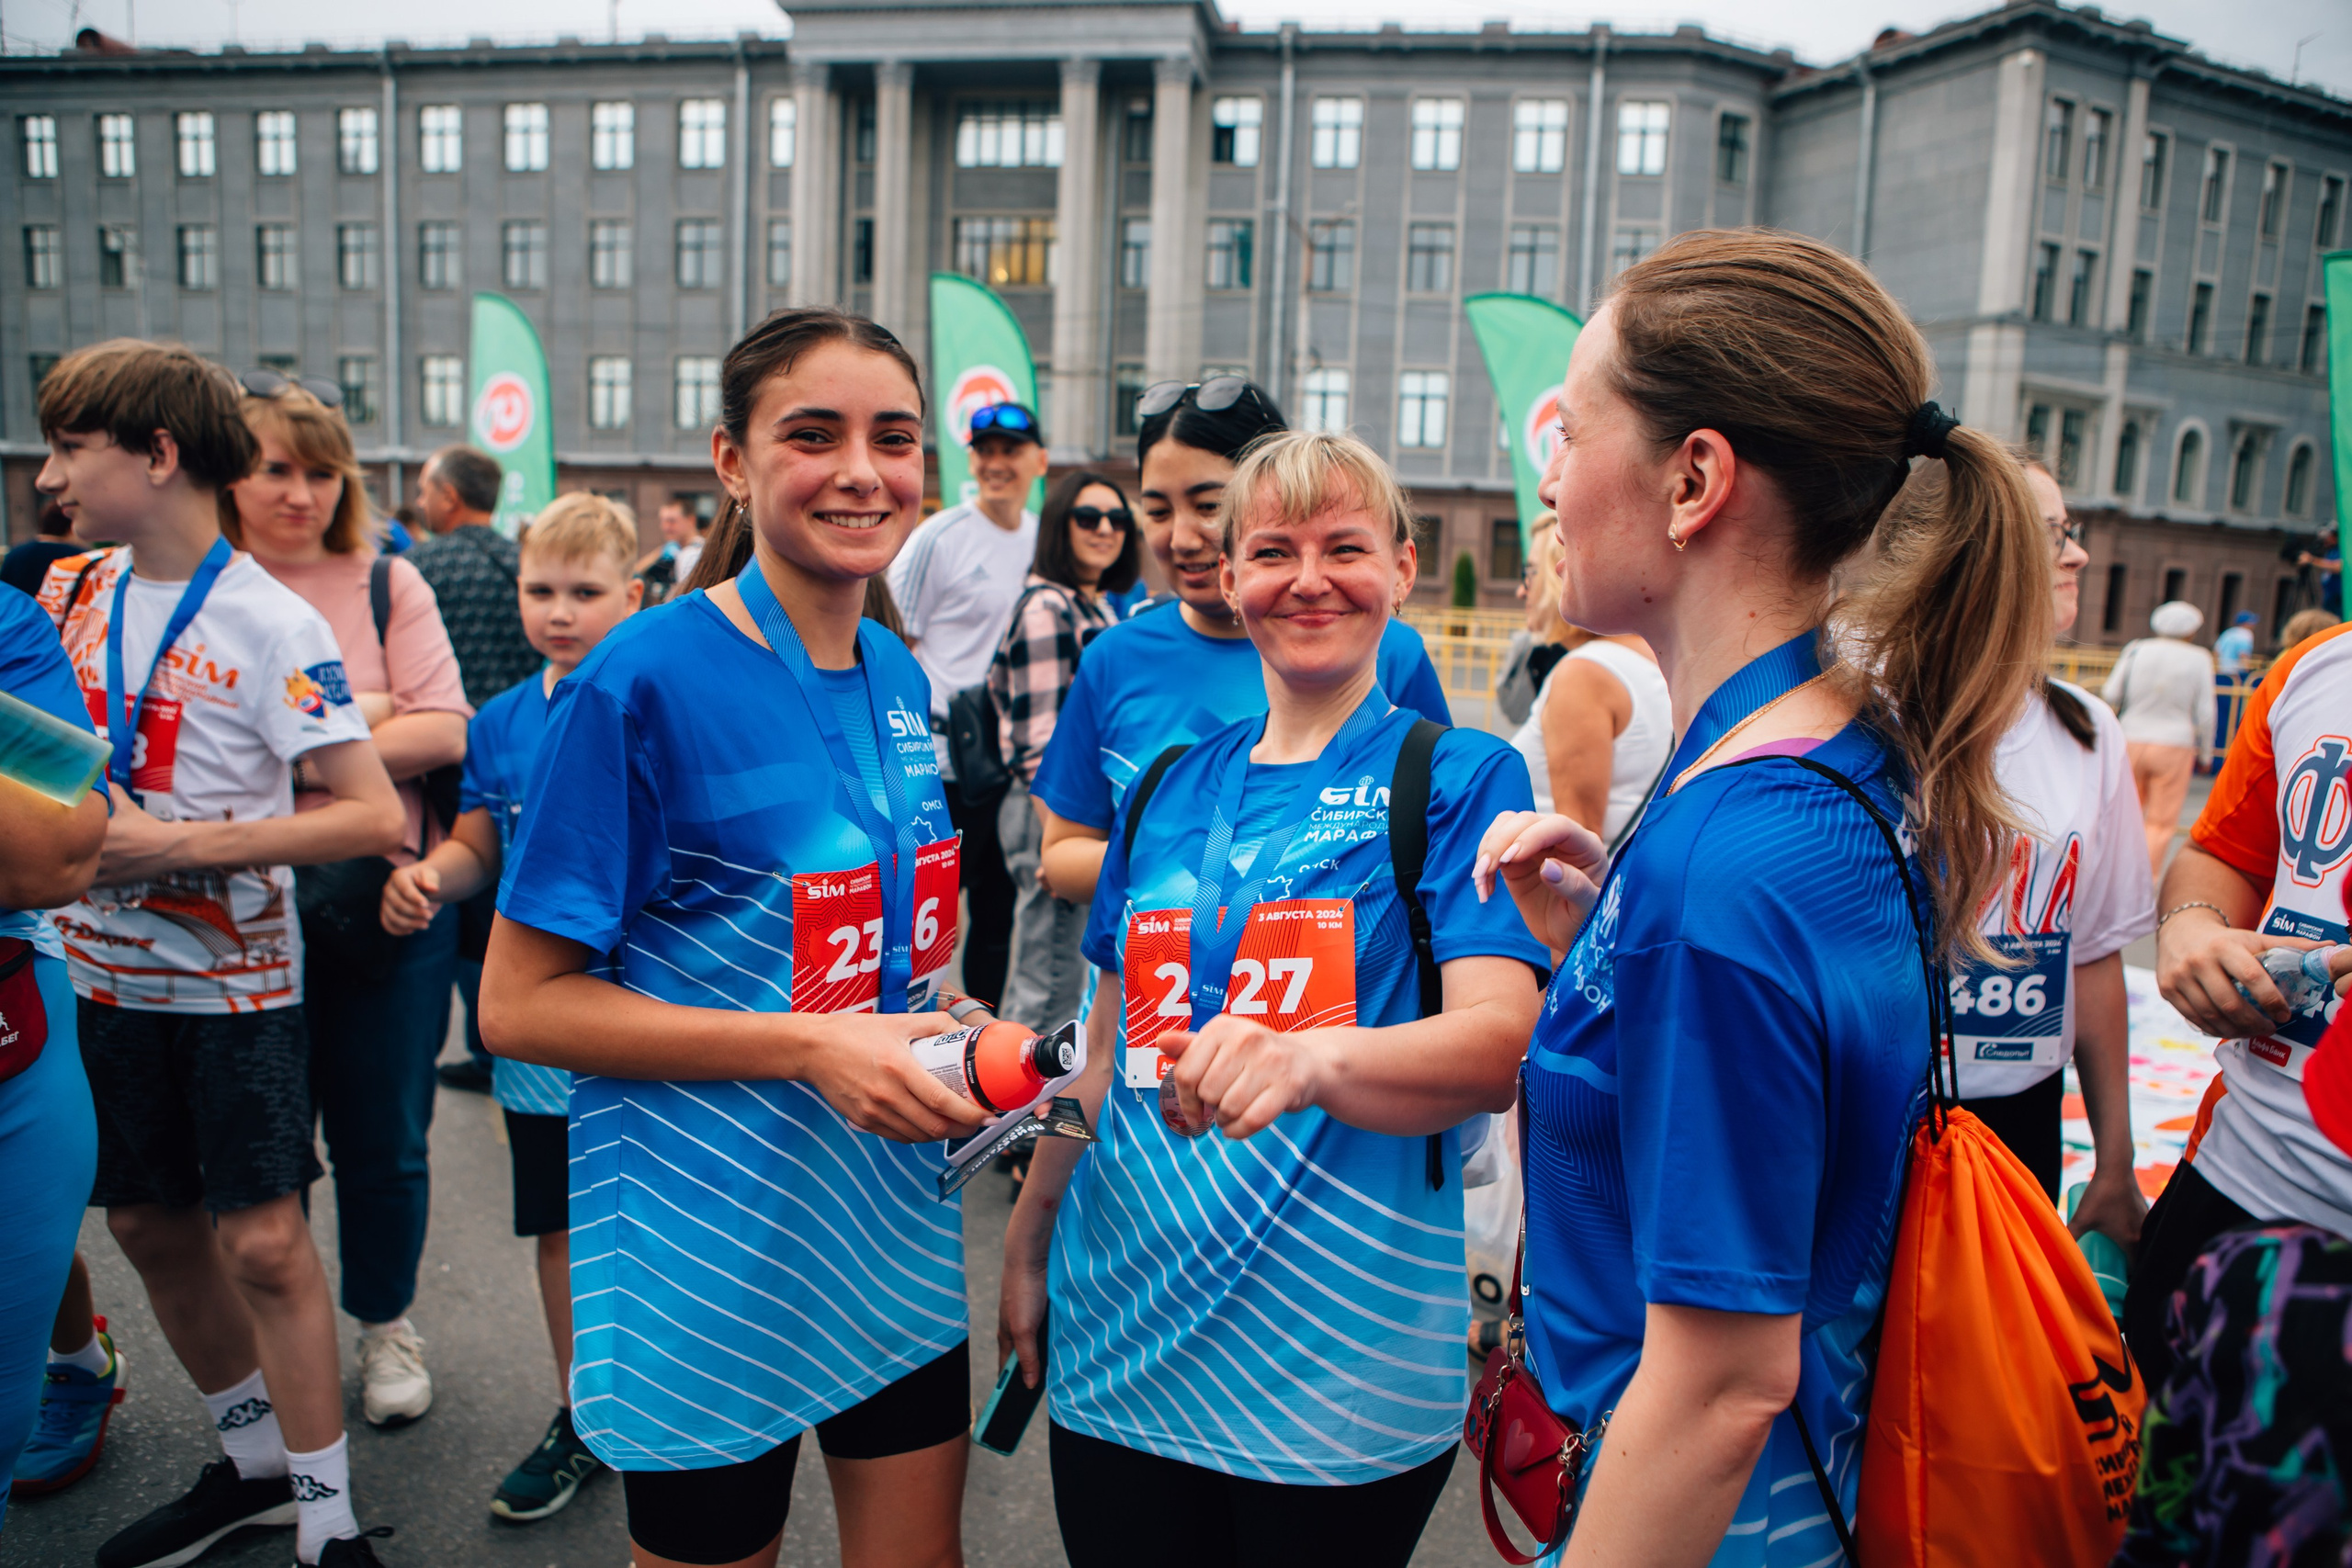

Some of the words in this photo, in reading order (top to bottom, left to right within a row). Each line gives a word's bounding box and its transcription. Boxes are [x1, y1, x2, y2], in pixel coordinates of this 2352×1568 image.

[922, 799, 944, 811] ОМСК
[1311, 807, 1387, 822] СИБИРСК
[1304, 829, 1389, 842] МАРАФ
[915, 853, 940, 867] ВГУСТА
[1258, 913, 1265, 922] 3
[1266, 910, 1314, 921] АВГУСТА
[1316, 909, 1344, 919] 2024
[827, 897, 940, 983] 236
[1154, 957, 1313, 1017] 227
[0, 1031, 20, 1047] БЕГ
